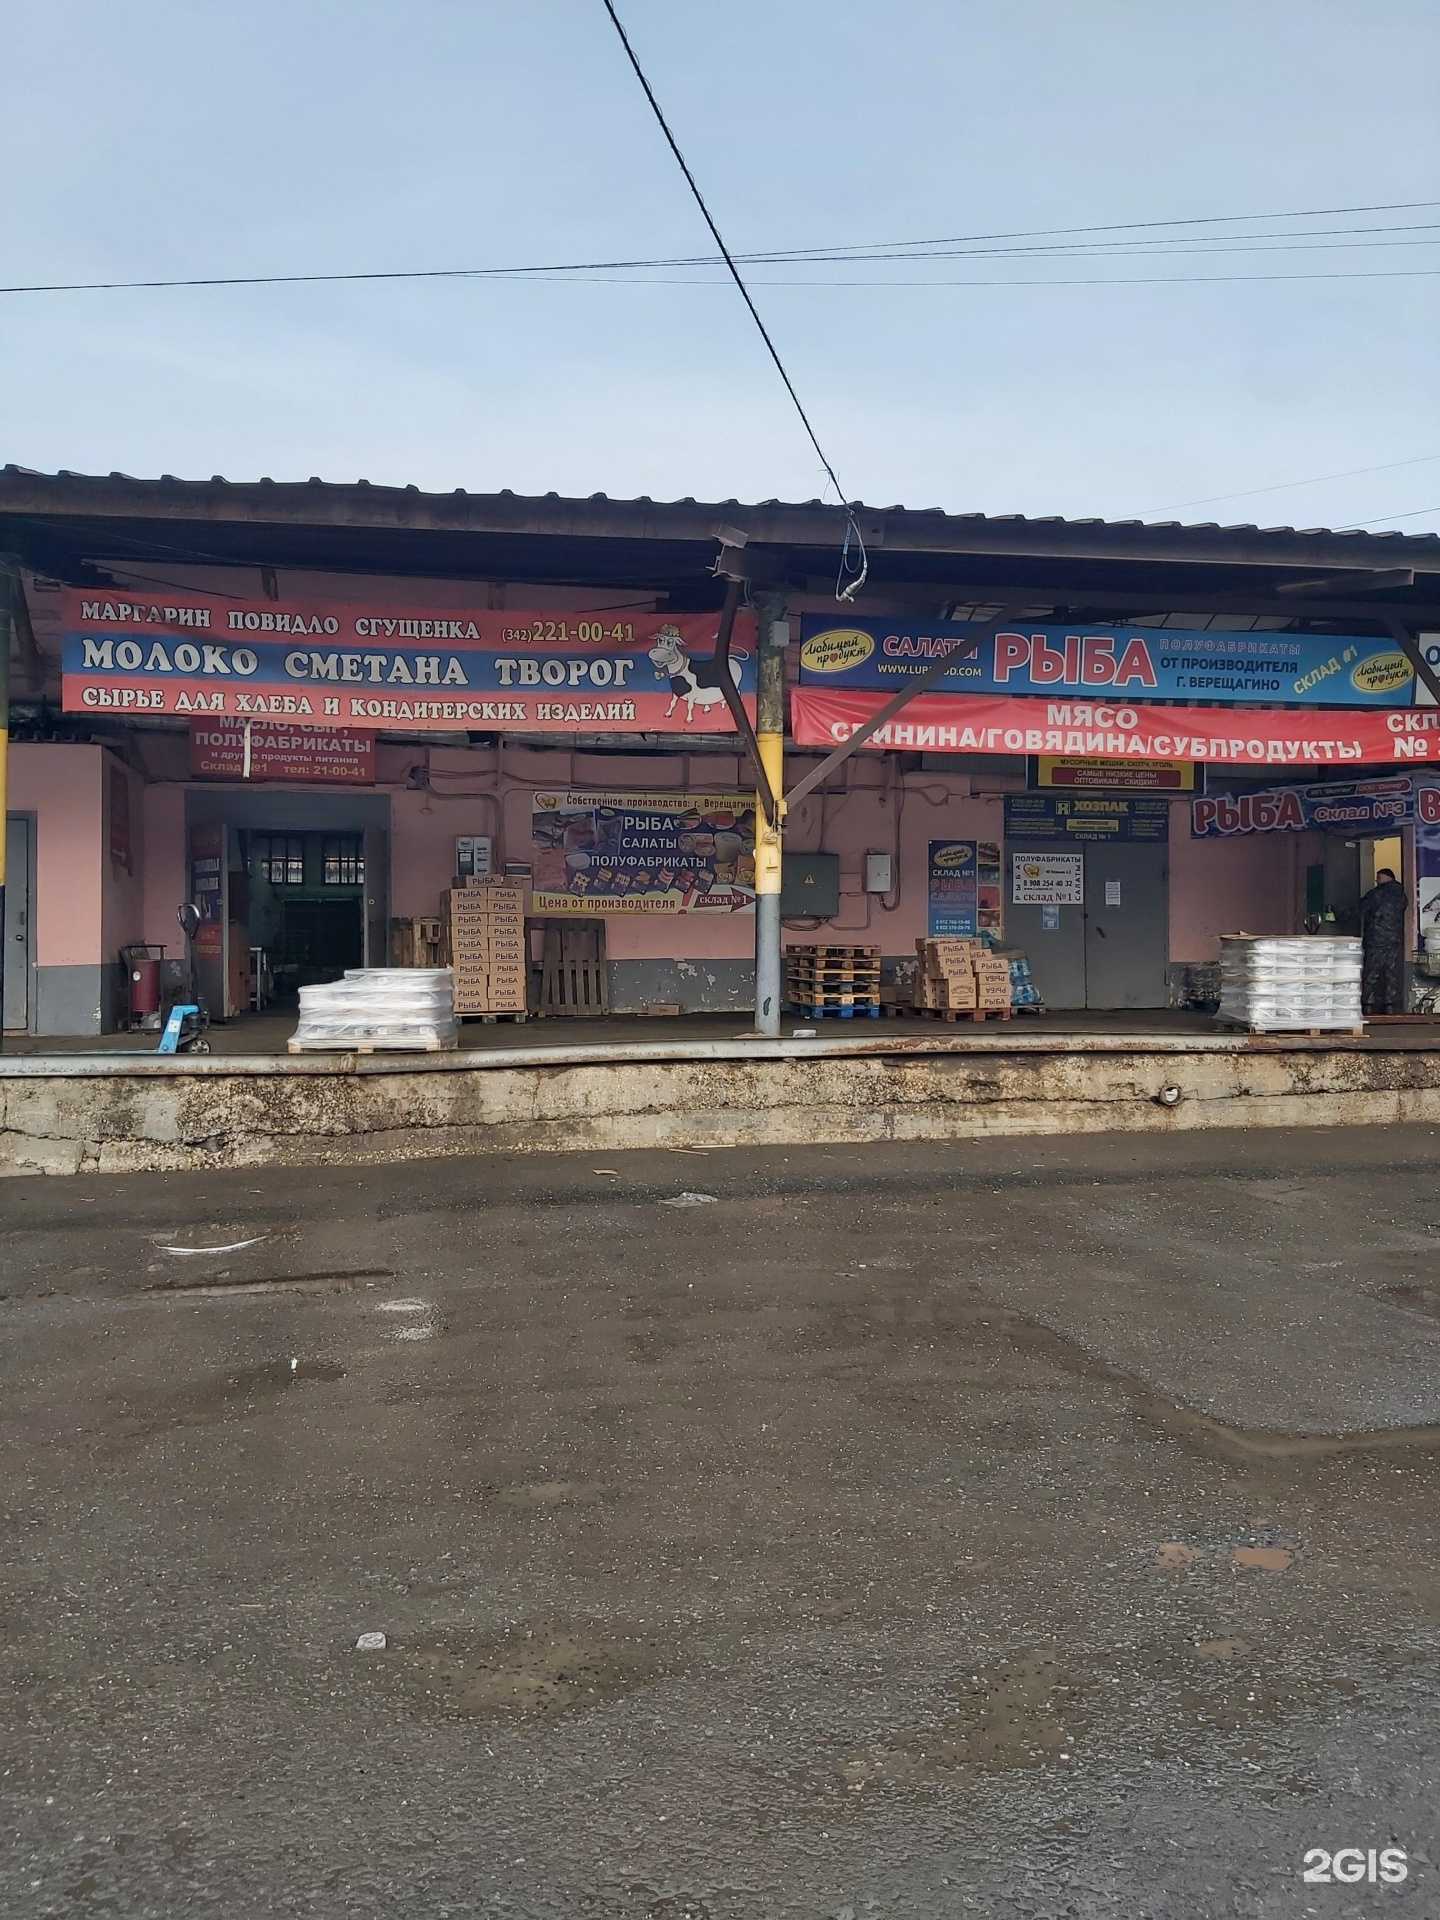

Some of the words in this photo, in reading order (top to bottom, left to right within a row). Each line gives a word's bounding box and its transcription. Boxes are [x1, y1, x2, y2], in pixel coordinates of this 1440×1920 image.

[81, 601, 211, 628] МАРГАРИН
[228, 611, 339, 634] ПОВИДЛО
[355, 617, 480, 640] СГУЩЕНКА
[1160, 638, 1300, 656] ПОЛУФАБРИКАТЫ
[82, 639, 258, 676] МОЛОКО
[284, 651, 469, 686] СМЕТАНА
[494, 658, 634, 686] ТВОРОГ
[993, 632, 1158, 688] РЫБА
[1160, 658, 1178, 668] ОТ
[1182, 658, 1298, 674] ПРОИЗВОДИТЕЛЯ
[878, 664, 982, 677] WWW.LUPD.COM
[1293, 656, 1342, 694] СКЛАД
[1176, 676, 1186, 688] Г.
[1189, 677, 1280, 691] ВЕРЕЩАГИНО
[82, 688, 164, 708] СЫРЬЕ
[175, 692, 226, 712] ДЛЯ
[236, 694, 313, 716] ХЛЕБА
[324, 697, 340, 716] И
[350, 698, 528, 720] КОНДИТЕРСКИХ
[537, 699, 636, 722] ИЗДЕЛИЙ
[1047, 704, 1138, 730] МЯСО
[1386, 714, 1440, 732] СКЛ
[196, 732, 371, 752] ПОЛУФАБРИКАТЫ
[261, 754, 312, 764] продукты
[315, 756, 359, 764] питания
[200, 761, 242, 773] Склад
[284, 766, 310, 775] тел:
[312, 766, 366, 776] 21-00-41
[566, 795, 622, 806] Собственное
[626, 797, 690, 809] производство:
[1192, 792, 1305, 834] РЫБА
[1314, 806, 1370, 821] Склад
[624, 816, 674, 831] РЫБА
[622, 837, 678, 849] САЛАТЫ
[591, 855, 707, 868] ПОЛУФАБРИКАТЫ
[932, 869, 960, 877] СКЛАД
[539, 896, 568, 910] Цена
[571, 899, 584, 908] от
[586, 898, 676, 911] производителя
[1024, 894, 1054, 902] склад
